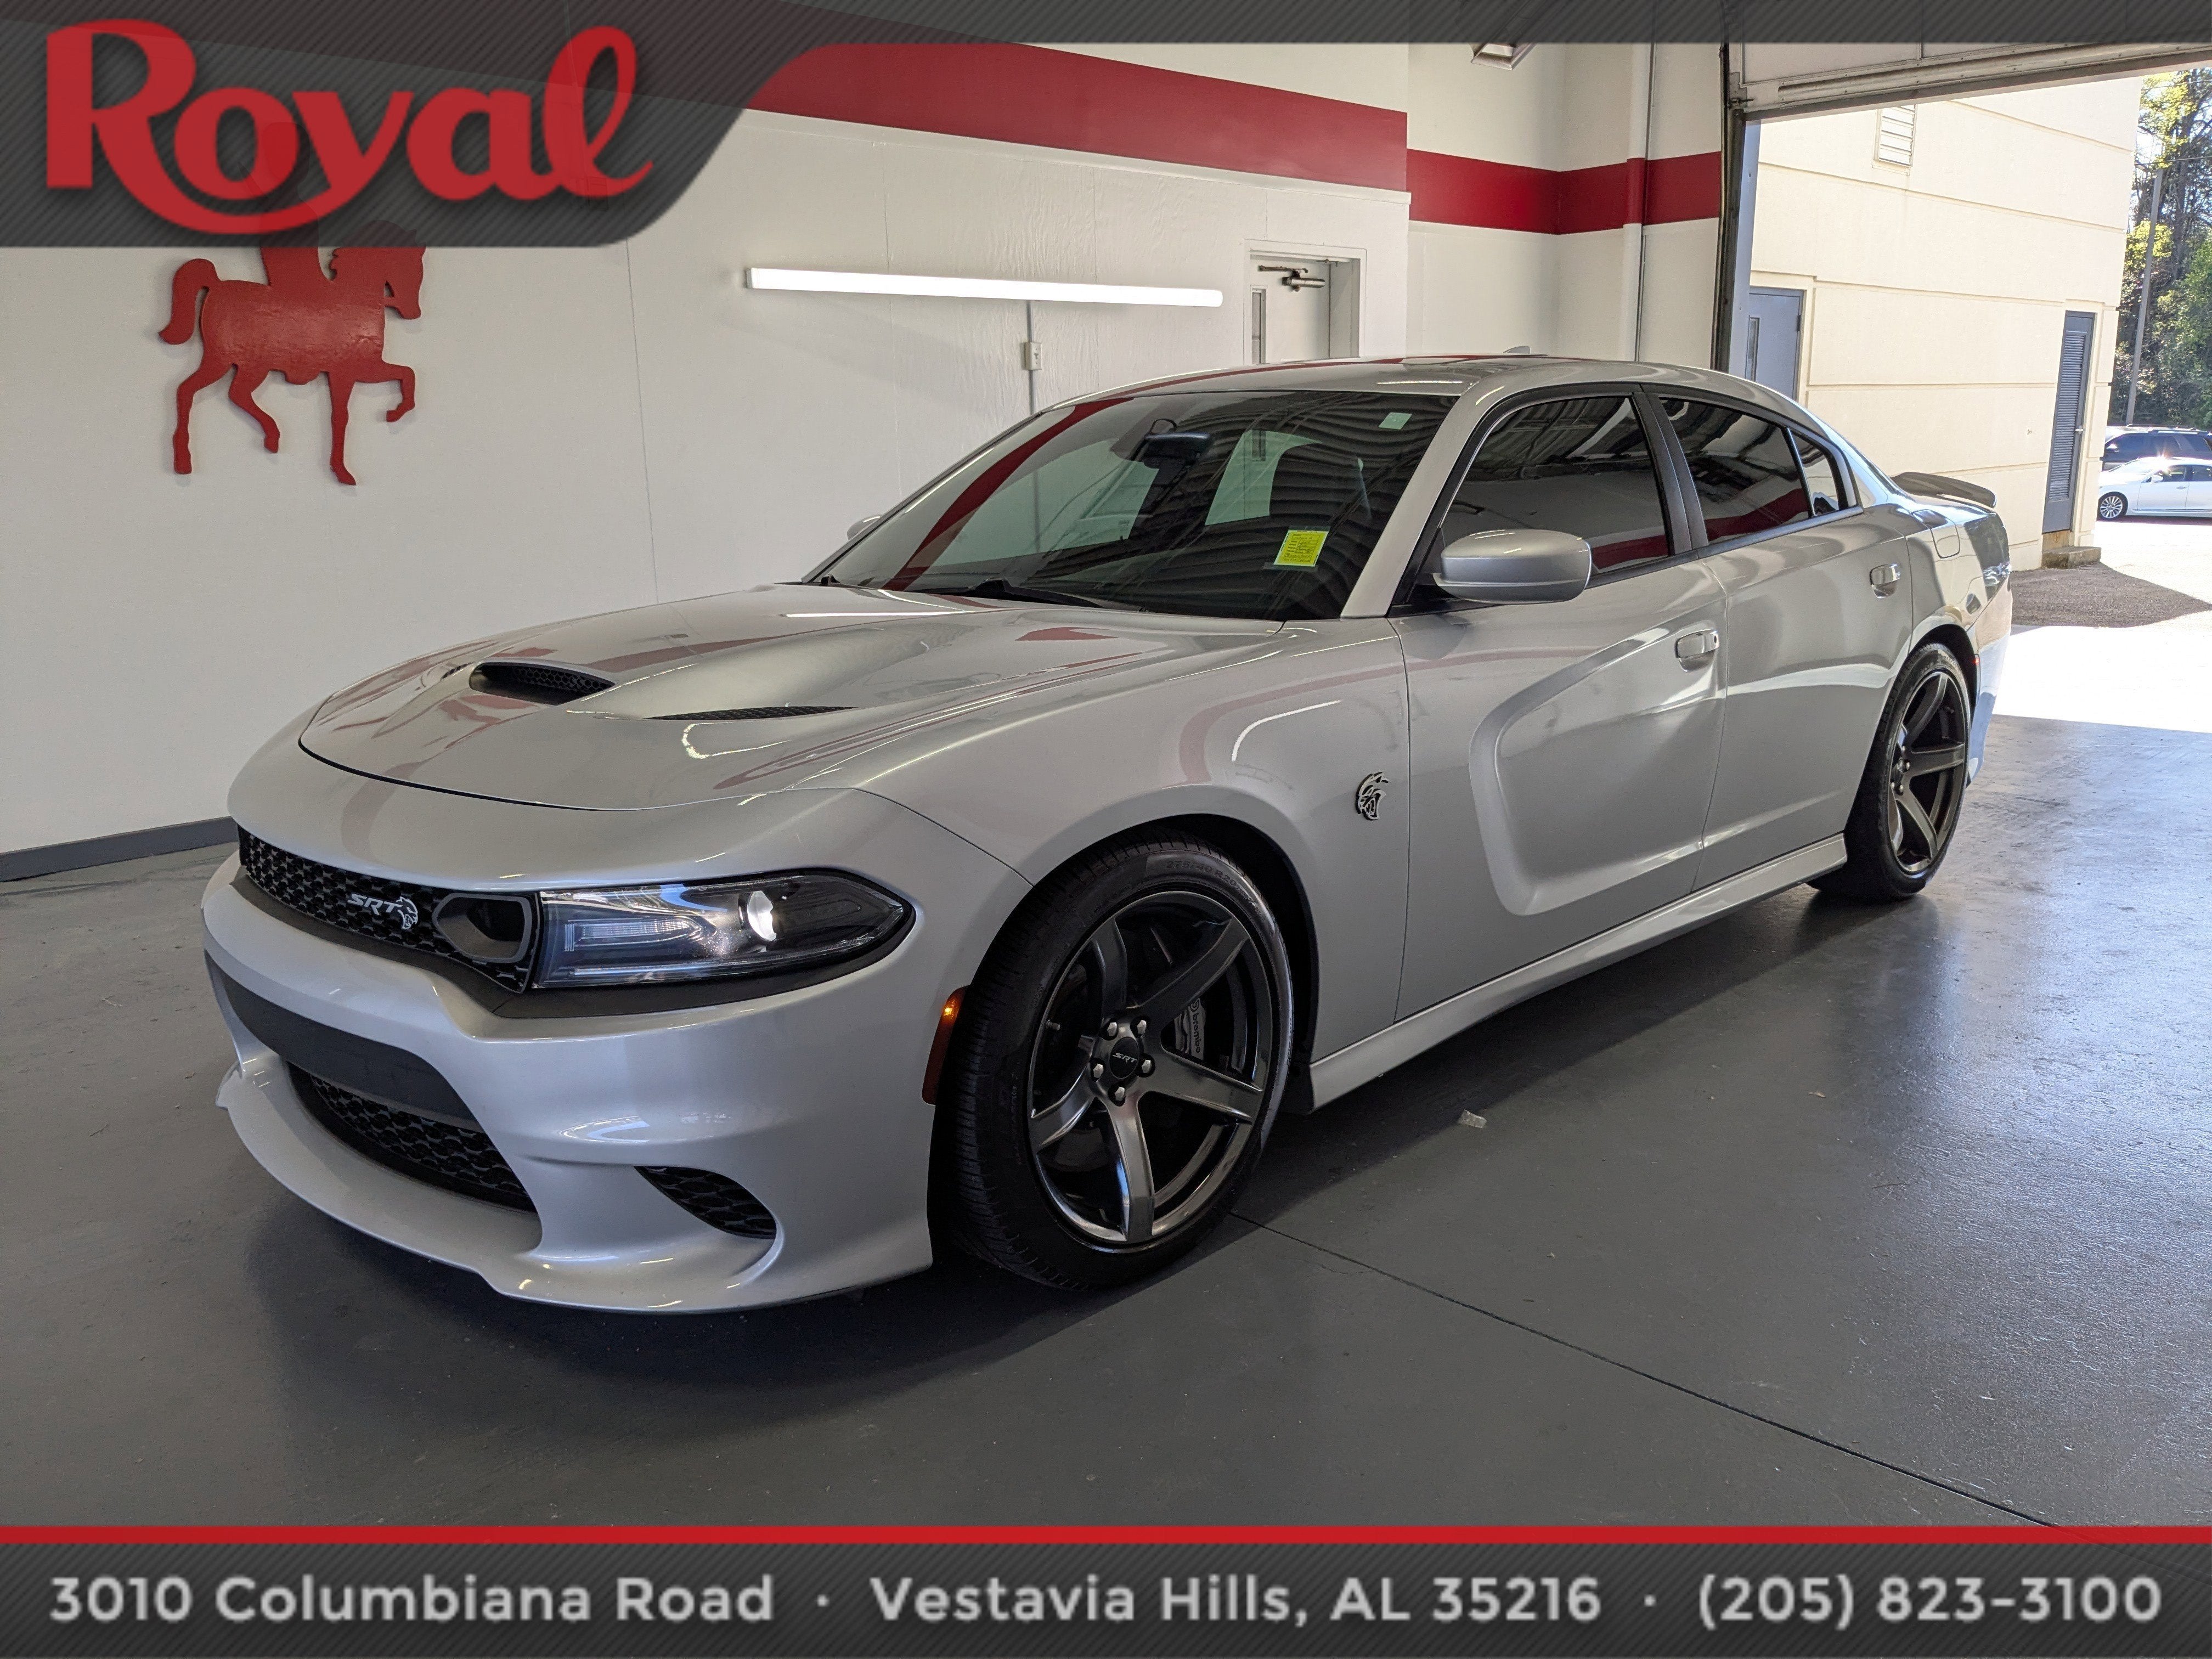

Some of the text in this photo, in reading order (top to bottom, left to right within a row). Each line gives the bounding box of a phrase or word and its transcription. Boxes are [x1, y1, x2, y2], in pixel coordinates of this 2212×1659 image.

[347, 893, 403, 916] SRT
[1192, 1012, 1201, 1053] brembo
[1112, 1052, 1138, 1063] SRT
